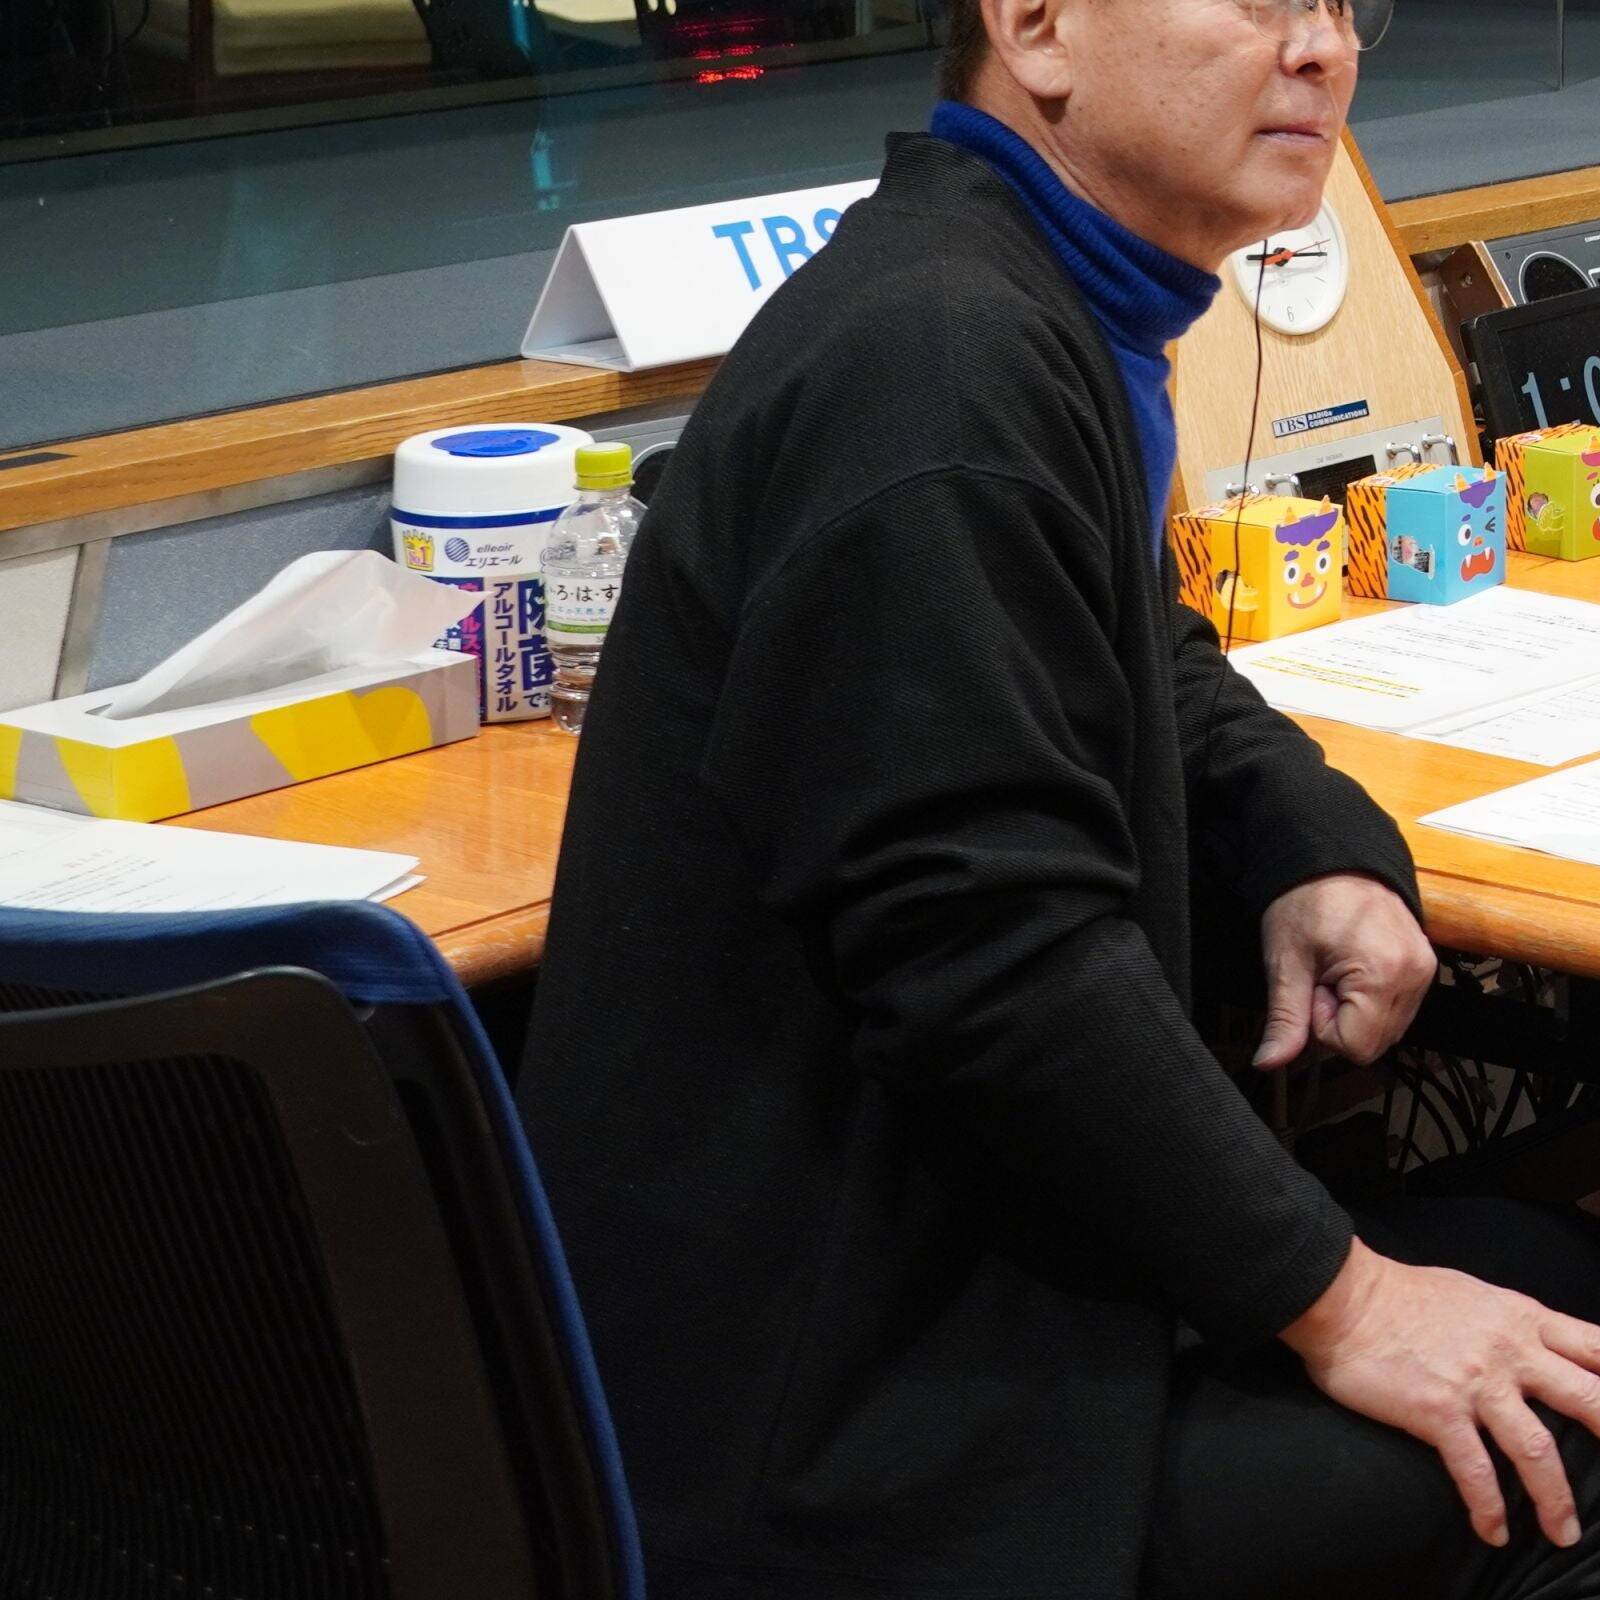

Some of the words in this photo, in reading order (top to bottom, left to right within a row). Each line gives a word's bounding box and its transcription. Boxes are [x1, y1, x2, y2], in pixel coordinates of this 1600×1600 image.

[1276, 416, 1307, 434] TBS
[476, 543, 514, 554] elleair
[466, 555, 523, 568] エリエール
[494, 582, 518, 712] アルコールタオル
